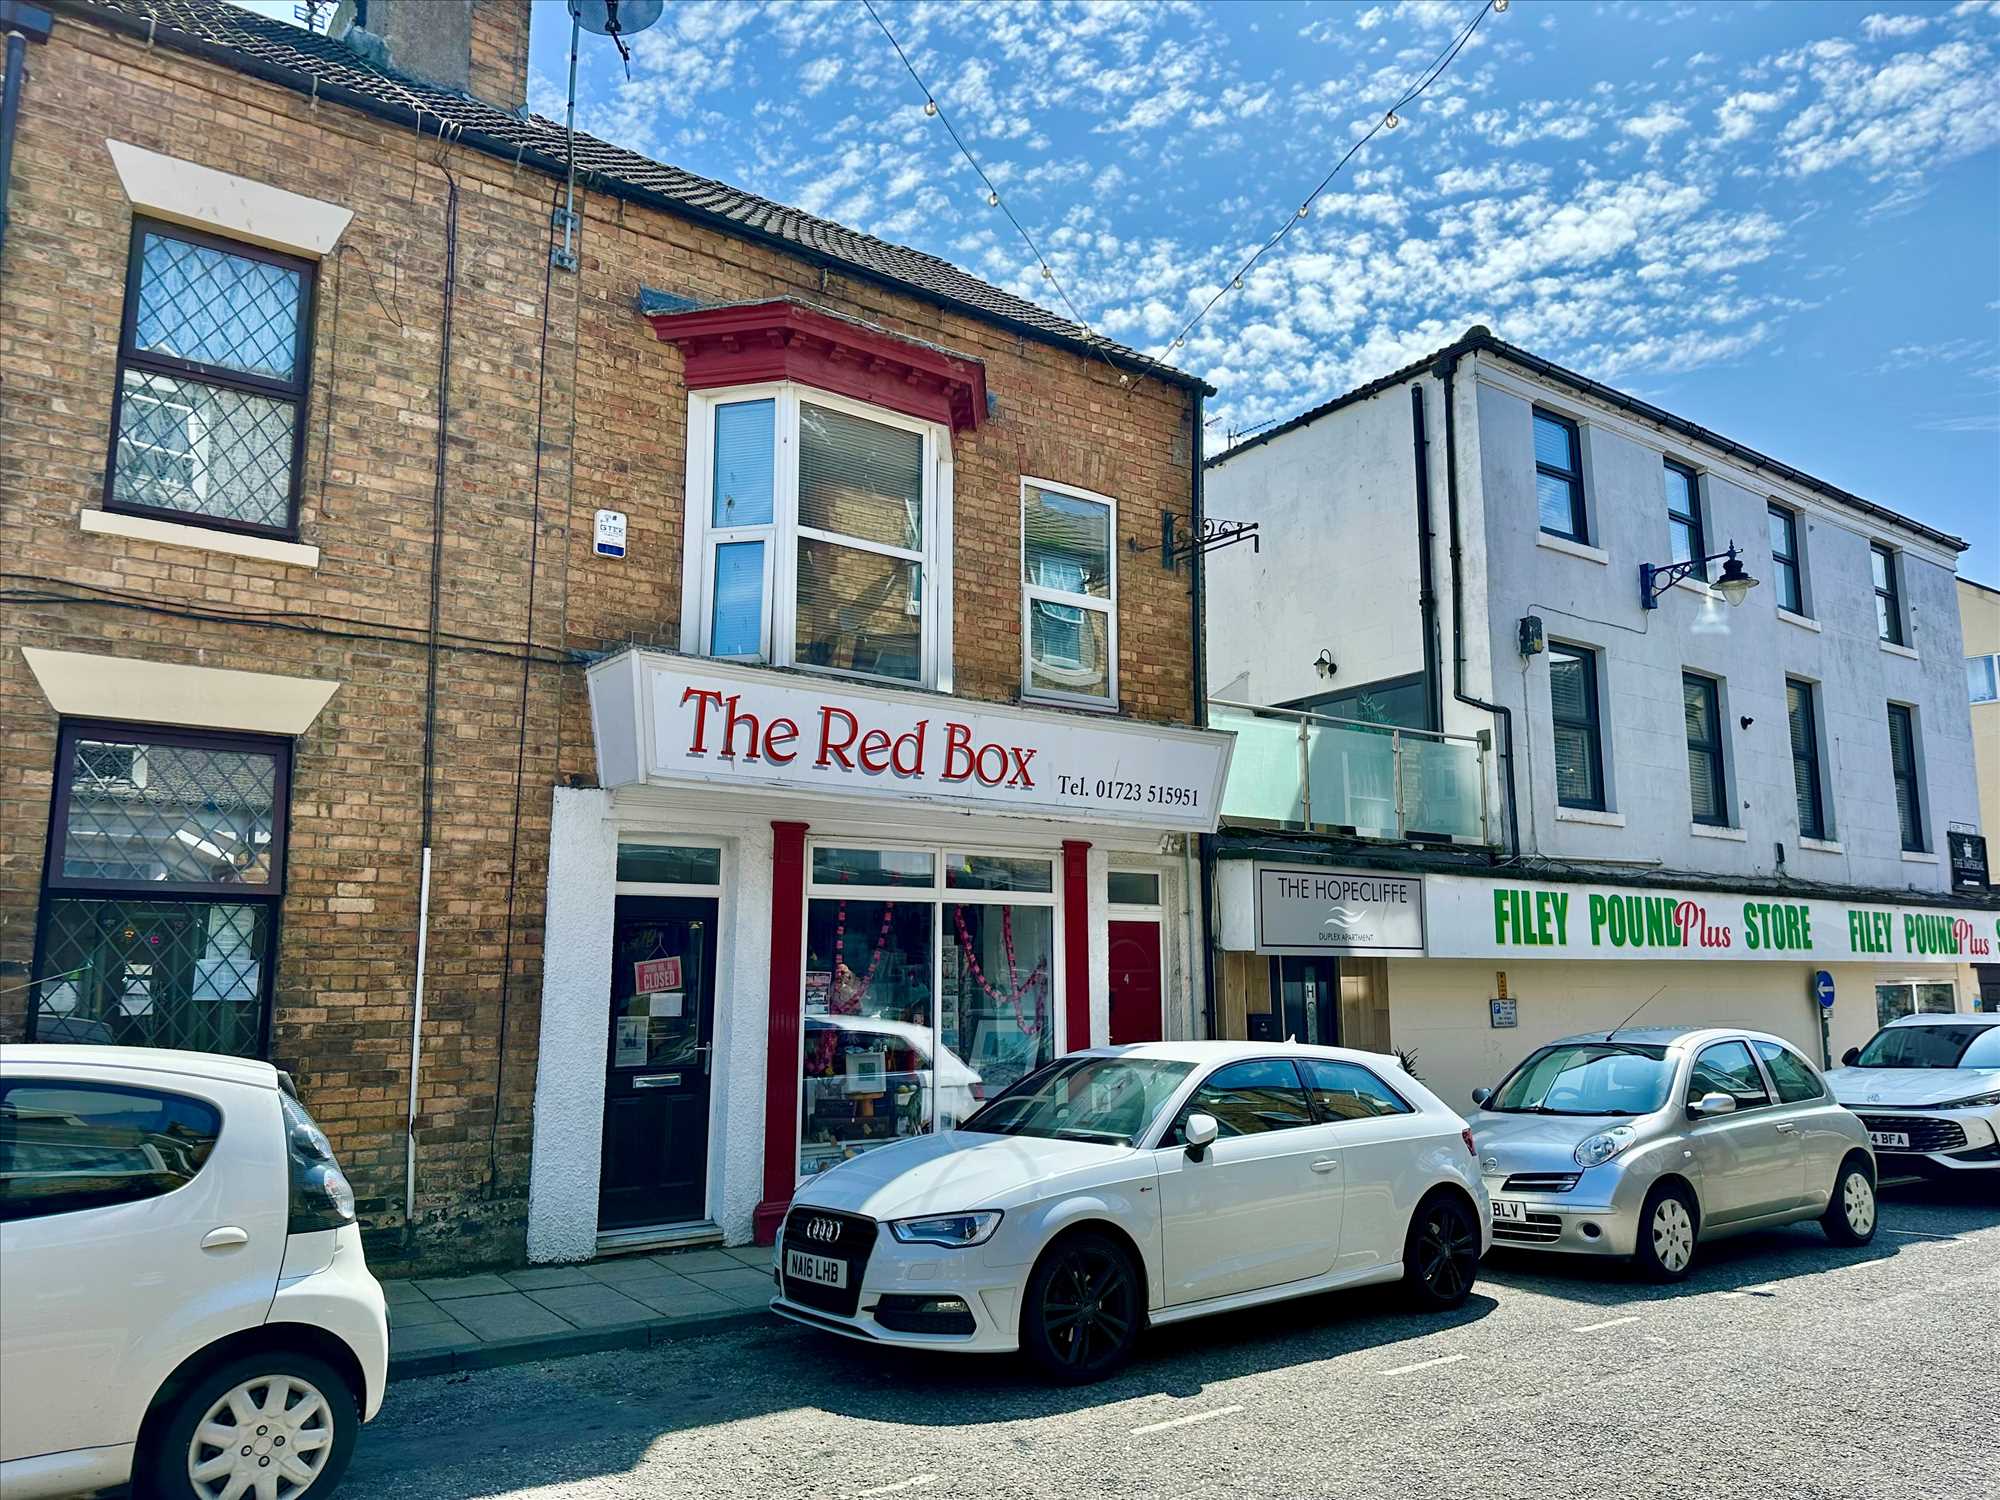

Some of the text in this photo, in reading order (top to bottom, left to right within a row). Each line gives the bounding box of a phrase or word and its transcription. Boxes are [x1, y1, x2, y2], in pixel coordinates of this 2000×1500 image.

[681, 686, 1038, 787] The Red Box
[1057, 775, 1199, 807] Tel. 01723 515951
[1278, 877, 1407, 904] THE HOPECLIFFE
[1493, 888, 1569, 946] FILEY
[1673, 900, 1731, 949] Plus
[1743, 902, 1813, 950] STORE
[1848, 910, 1893, 953] FILEY
[1318, 932, 1374, 943] DUPLEX APARTMENT
[643, 970, 676, 989] CLOSED
[1123, 973, 1129, 985] 4
[1881, 1133, 1905, 1145] BFA
[1492, 1202, 1519, 1219] BLV
[791, 1253, 839, 1283] NA16 LHB
